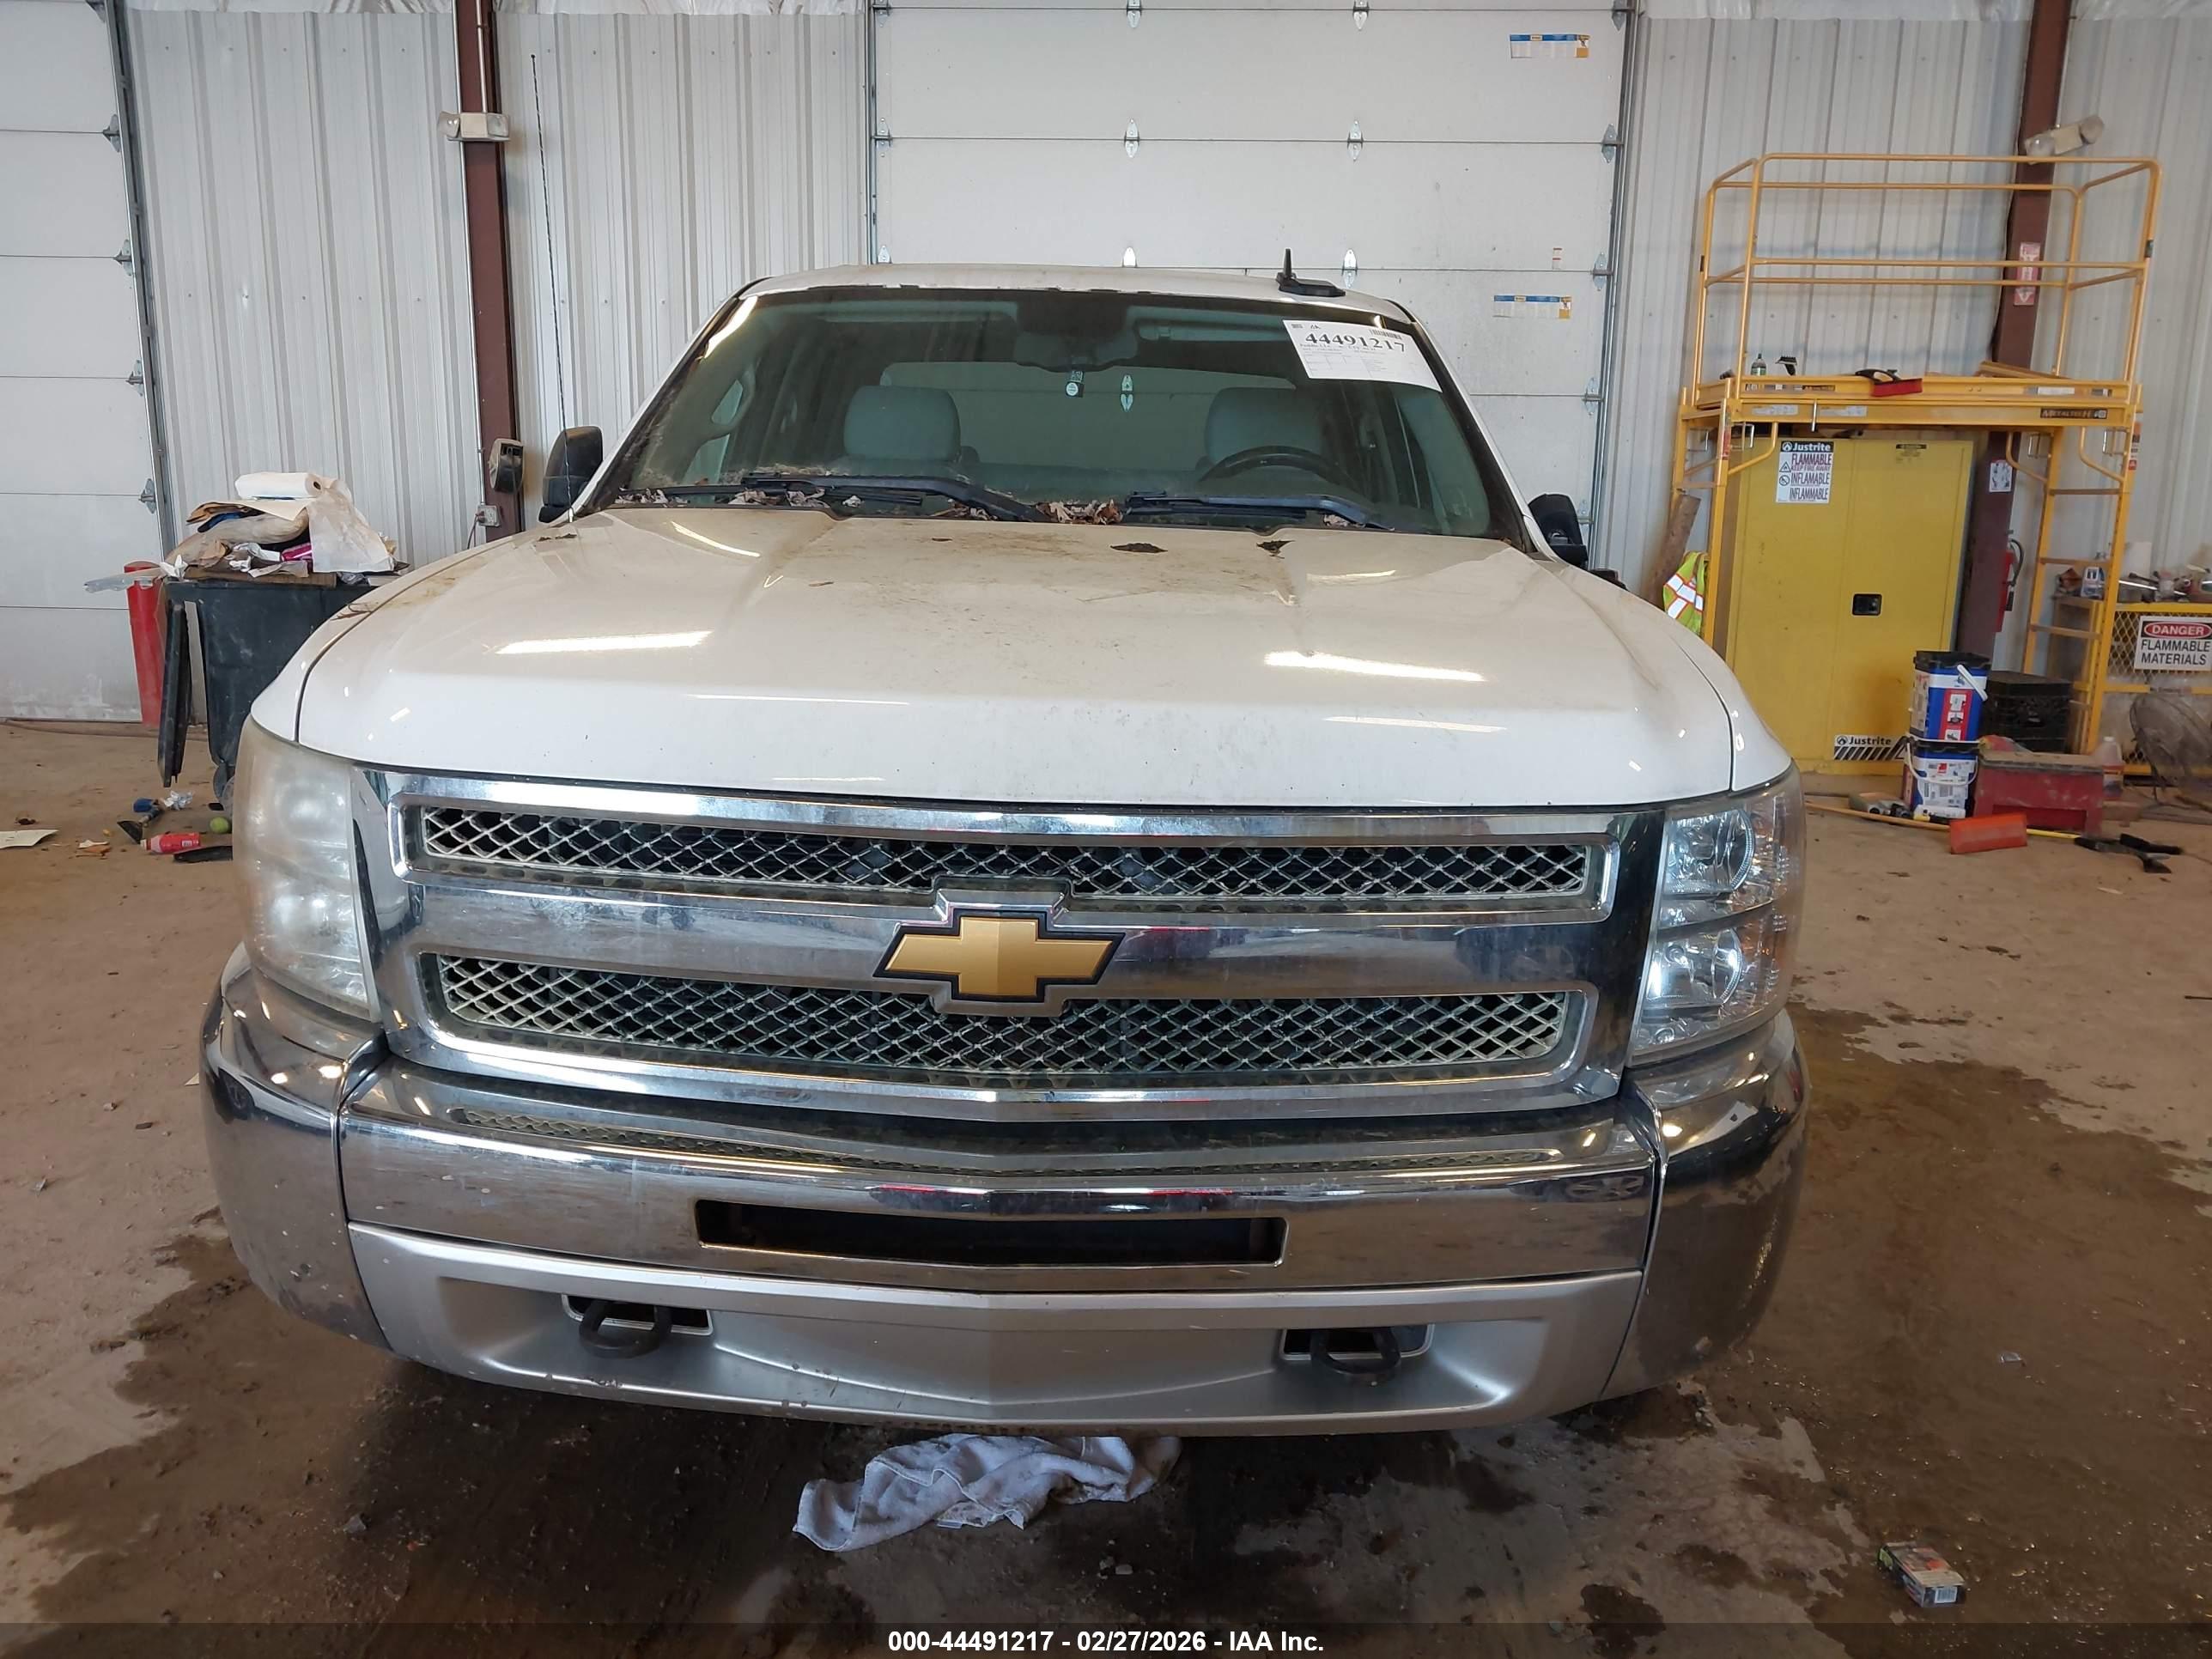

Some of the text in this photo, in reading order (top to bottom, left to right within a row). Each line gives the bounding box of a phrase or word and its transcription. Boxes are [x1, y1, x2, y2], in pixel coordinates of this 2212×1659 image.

[1305, 332, 1405, 353] 44491217
[1792, 442, 1831, 452] Justrite
[1791, 453, 1832, 465] FLAMMABLE
[1790, 472, 1831, 484] INFLAMABLE
[1790, 487, 1829, 500] INFLAMMABLE
[2151, 624, 2204, 635] DANGER
[2141, 639, 2211, 653] FLAMMABLE
[2141, 653, 2207, 665] MATERIALS
[1849, 736, 1892, 745] Justrite
